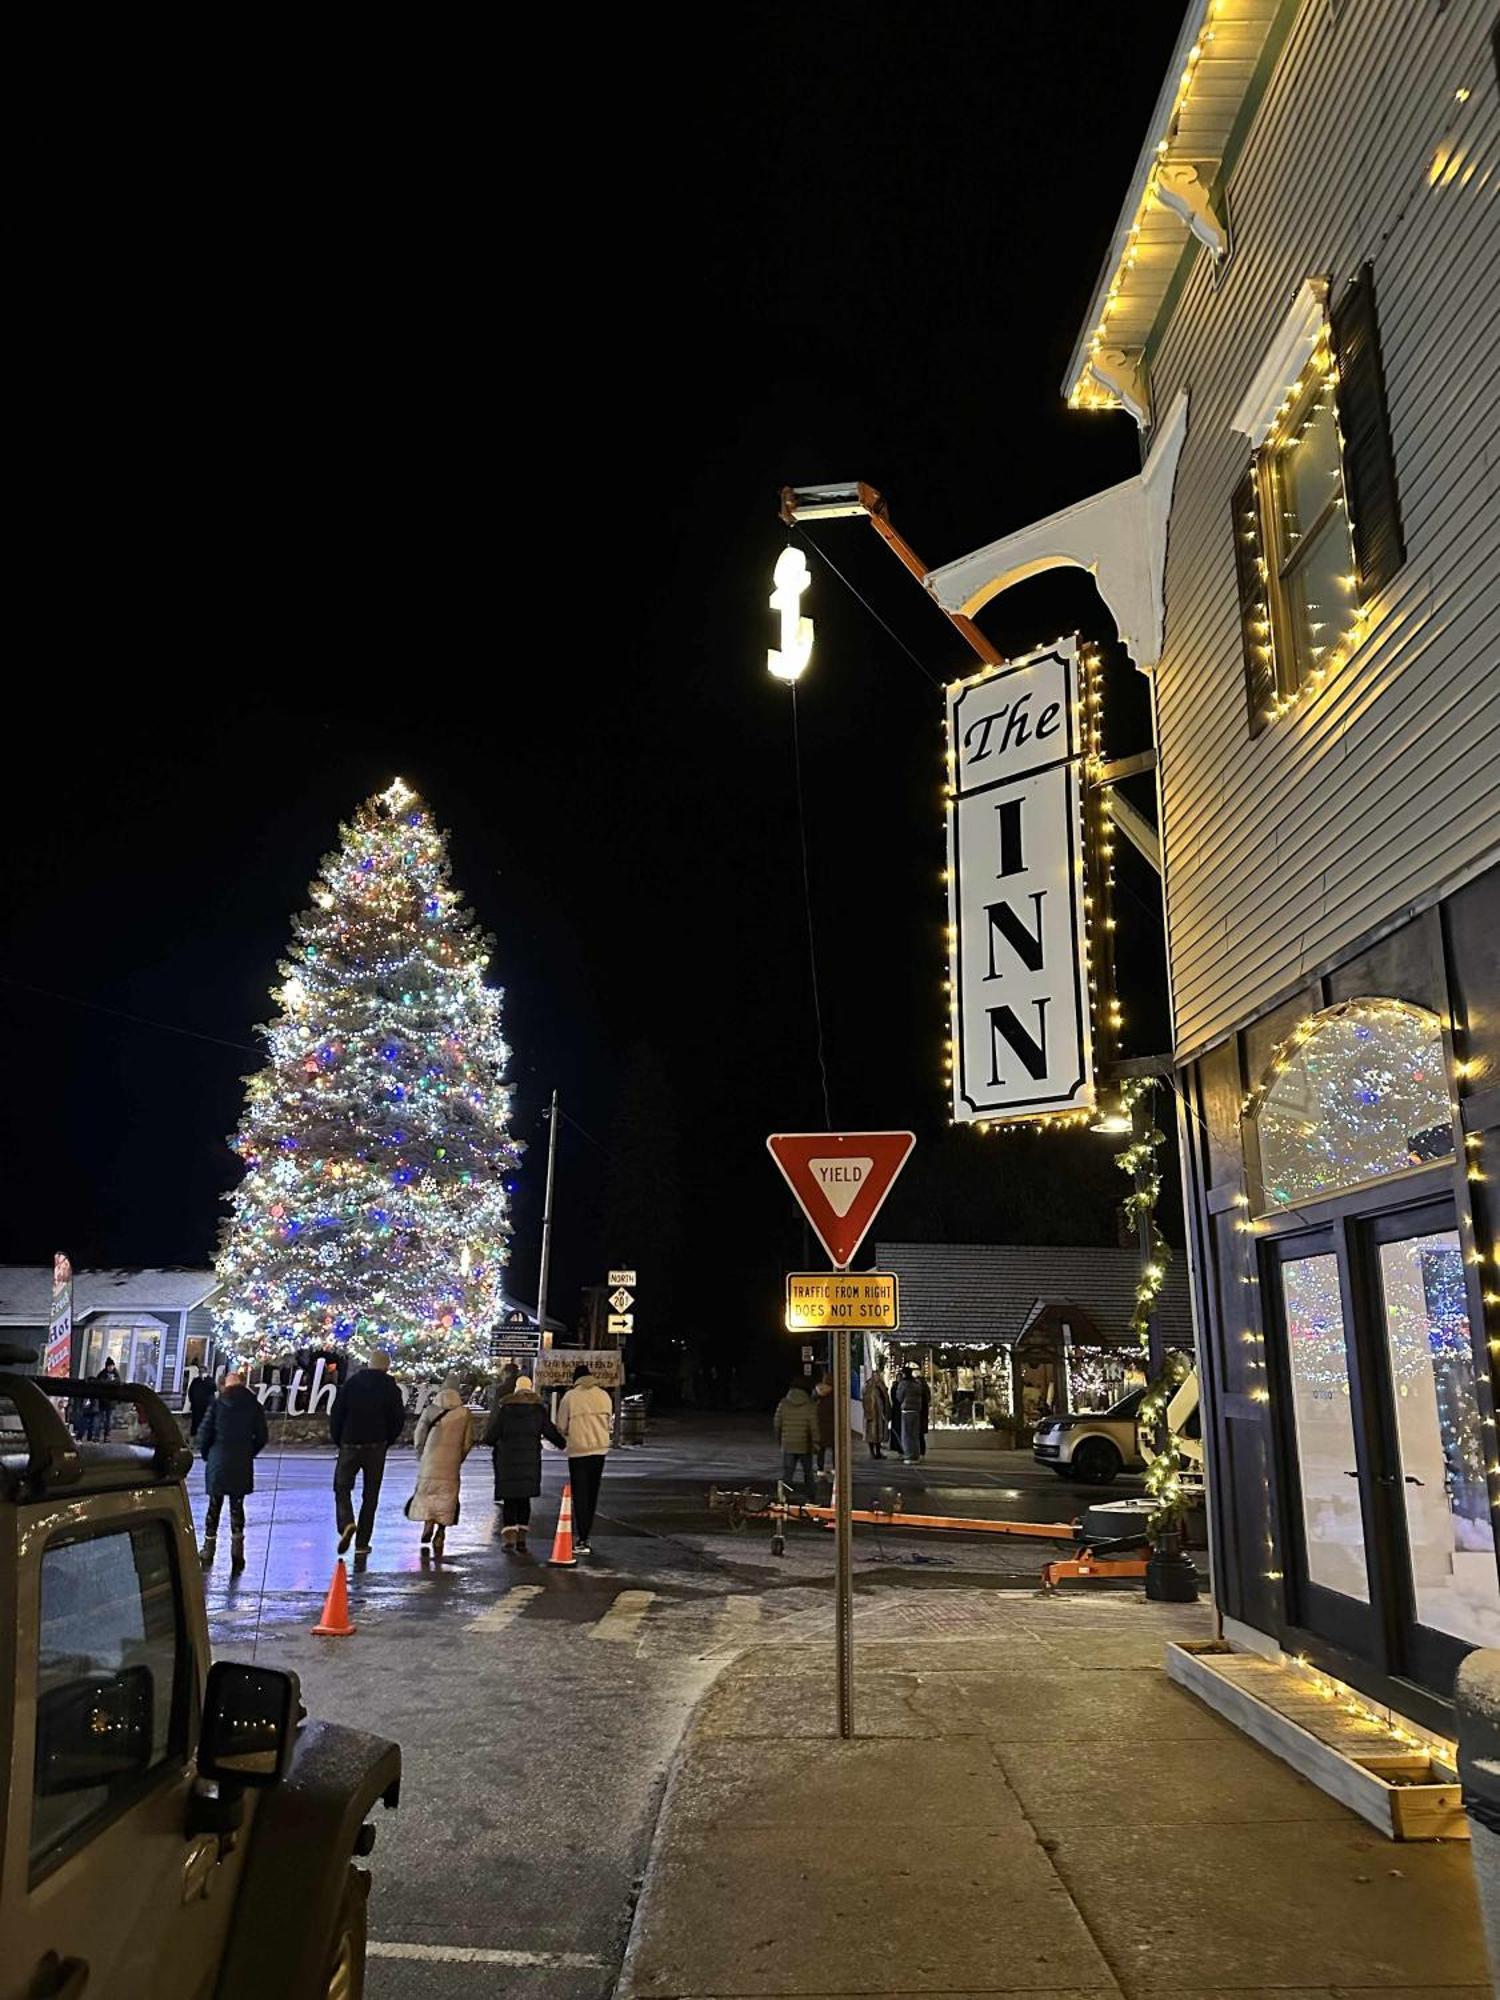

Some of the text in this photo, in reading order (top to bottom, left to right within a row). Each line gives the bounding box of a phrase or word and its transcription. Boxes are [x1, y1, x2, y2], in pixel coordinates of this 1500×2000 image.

[963, 692, 1060, 765] The
[982, 796, 1051, 1088] INN
[819, 1167, 862, 1182] YIELD
[611, 1274, 634, 1283] NORTH
[793, 1286, 891, 1298] TRAFFIC FROM RIGHT
[614, 1295, 628, 1307] 201
[795, 1304, 890, 1316] DOES NOT STOP
[48, 1318, 69, 1344] Hot
